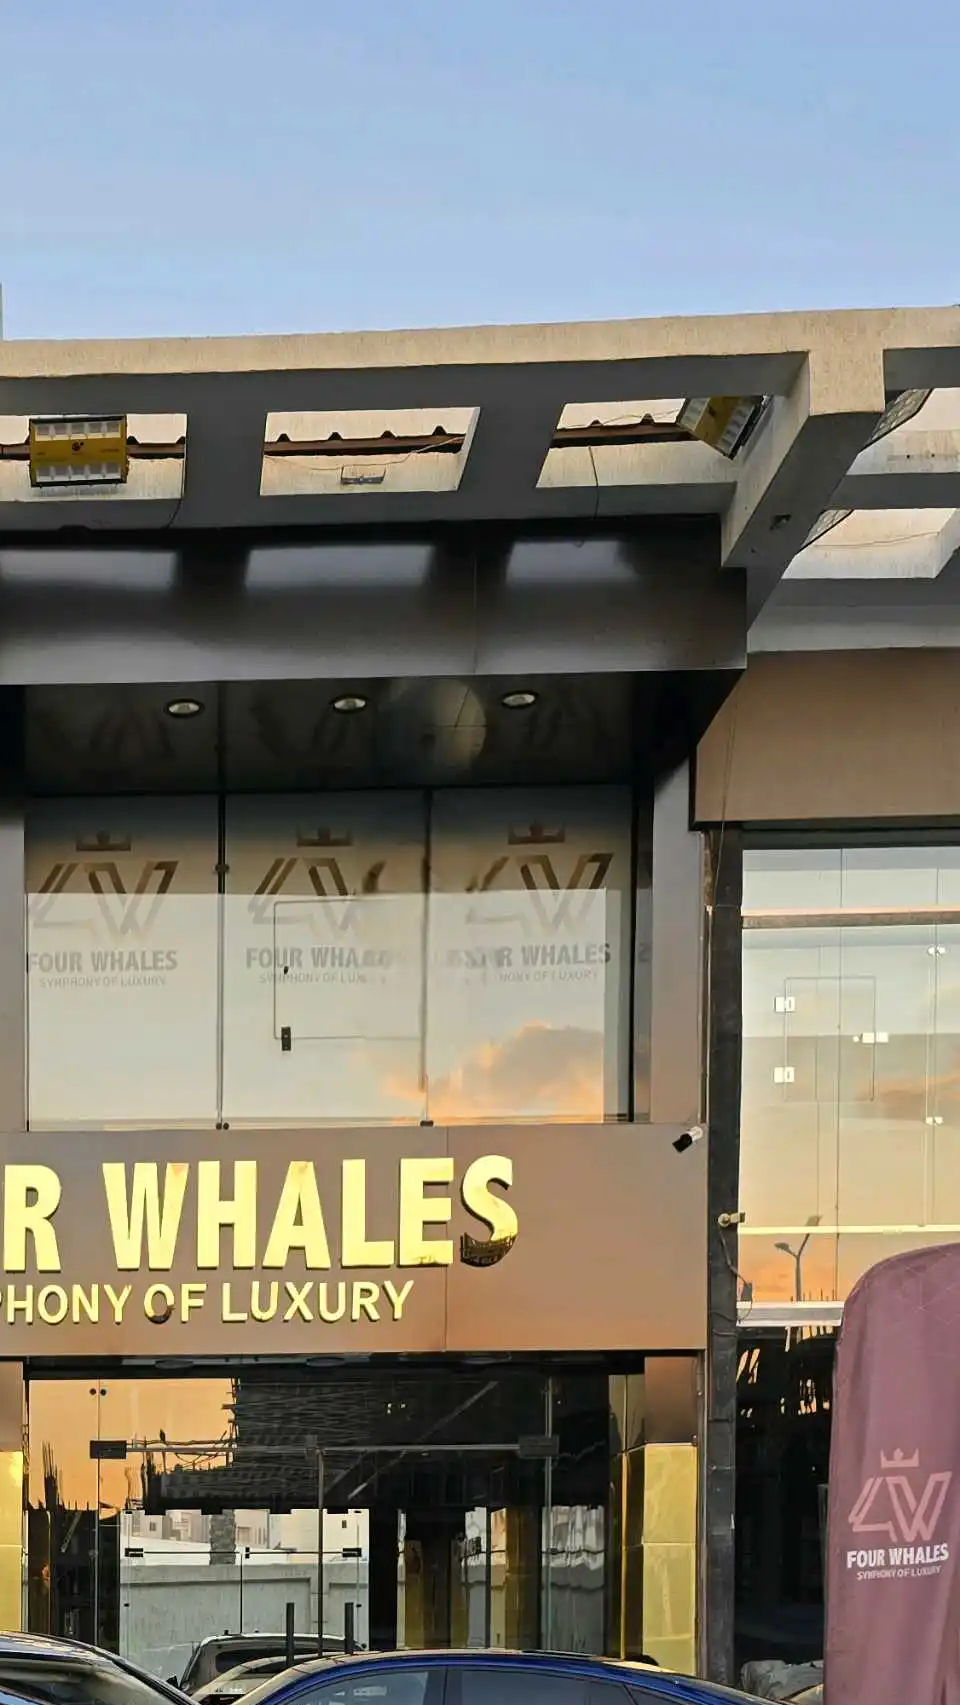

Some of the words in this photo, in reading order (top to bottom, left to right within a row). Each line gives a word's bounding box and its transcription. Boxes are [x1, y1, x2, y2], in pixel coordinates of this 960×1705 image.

[28, 952, 83, 973] FOUR
[91, 950, 178, 973] WHALES
[246, 948, 303, 969] FOUR
[521, 943, 611, 966] WHALES
[102, 1154, 519, 1271] WHALES
[143, 1282, 207, 1324] OF
[222, 1280, 415, 1323] LUXURY
[846, 1549, 886, 1568] FOUR
[888, 1543, 949, 1566] WHALES
